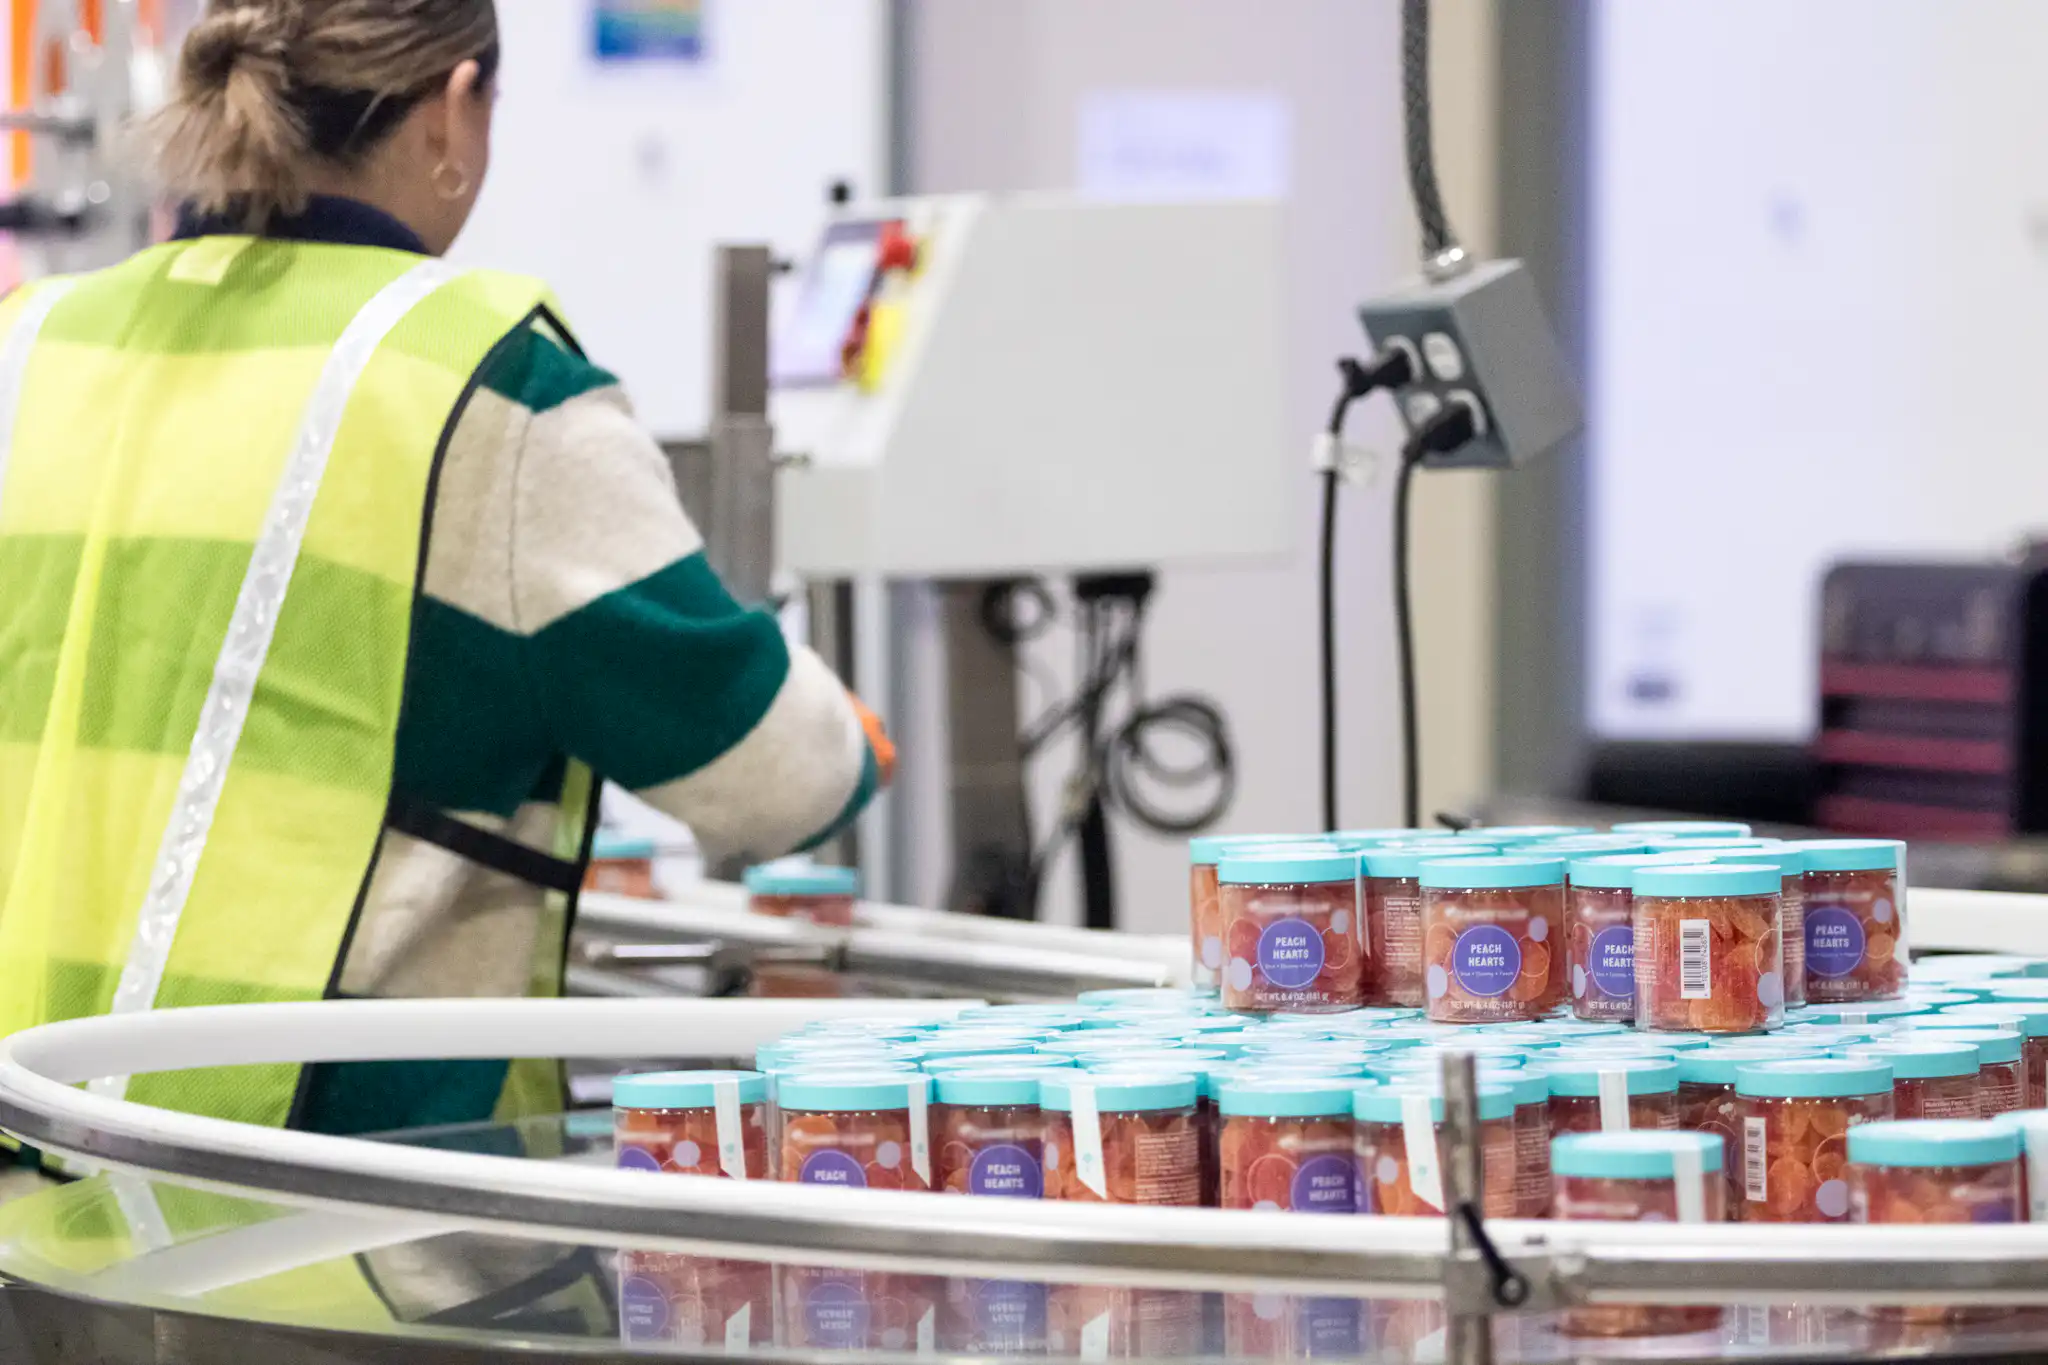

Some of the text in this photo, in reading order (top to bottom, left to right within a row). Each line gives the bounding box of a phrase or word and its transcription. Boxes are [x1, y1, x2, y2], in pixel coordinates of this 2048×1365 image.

[1815, 925, 1847, 935] PEACH
[1275, 936, 1307, 947] PEACH
[1813, 938, 1850, 948] HEARTS
[1470, 943, 1502, 954] PEACH
[1272, 949, 1309, 960] HEARTS
[1468, 956, 1505, 967] HEARTS
[814, 1169, 848, 1181] PEACH
[987, 1164, 1022, 1175] PEACH
[984, 1178, 1025, 1189] HEARTS
